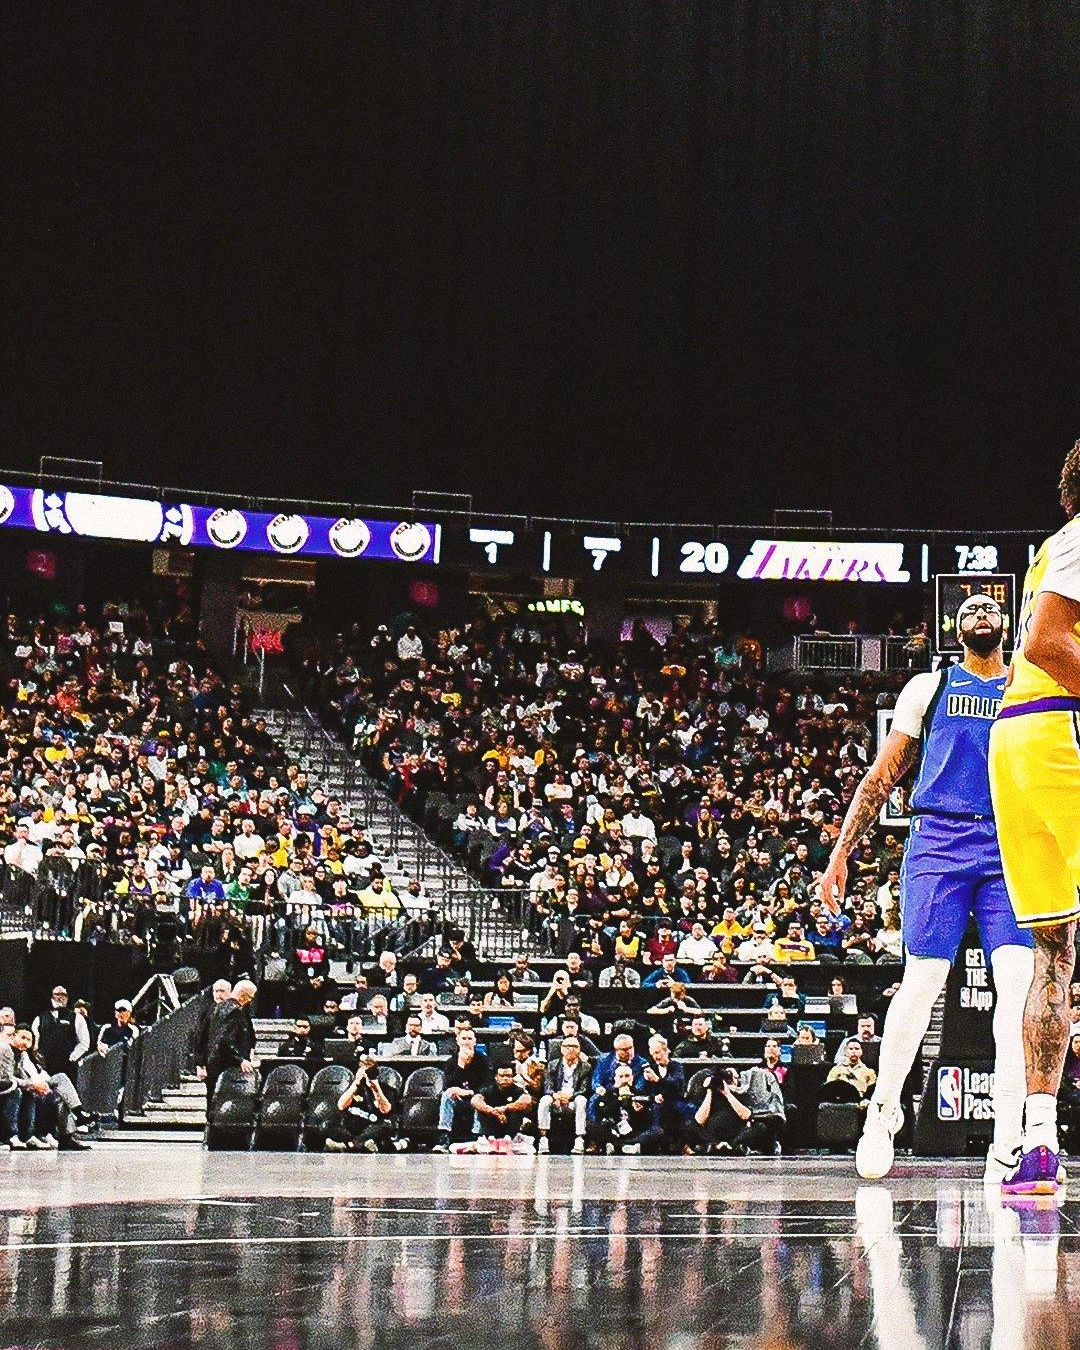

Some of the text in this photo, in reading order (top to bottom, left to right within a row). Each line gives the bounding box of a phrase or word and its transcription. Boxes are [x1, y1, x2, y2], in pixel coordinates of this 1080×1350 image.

[484, 542, 498, 564] 1
[591, 549, 608, 571] 7
[679, 541, 729, 574] 20
[966, 967, 988, 987] THE
[971, 987, 993, 1011] App
